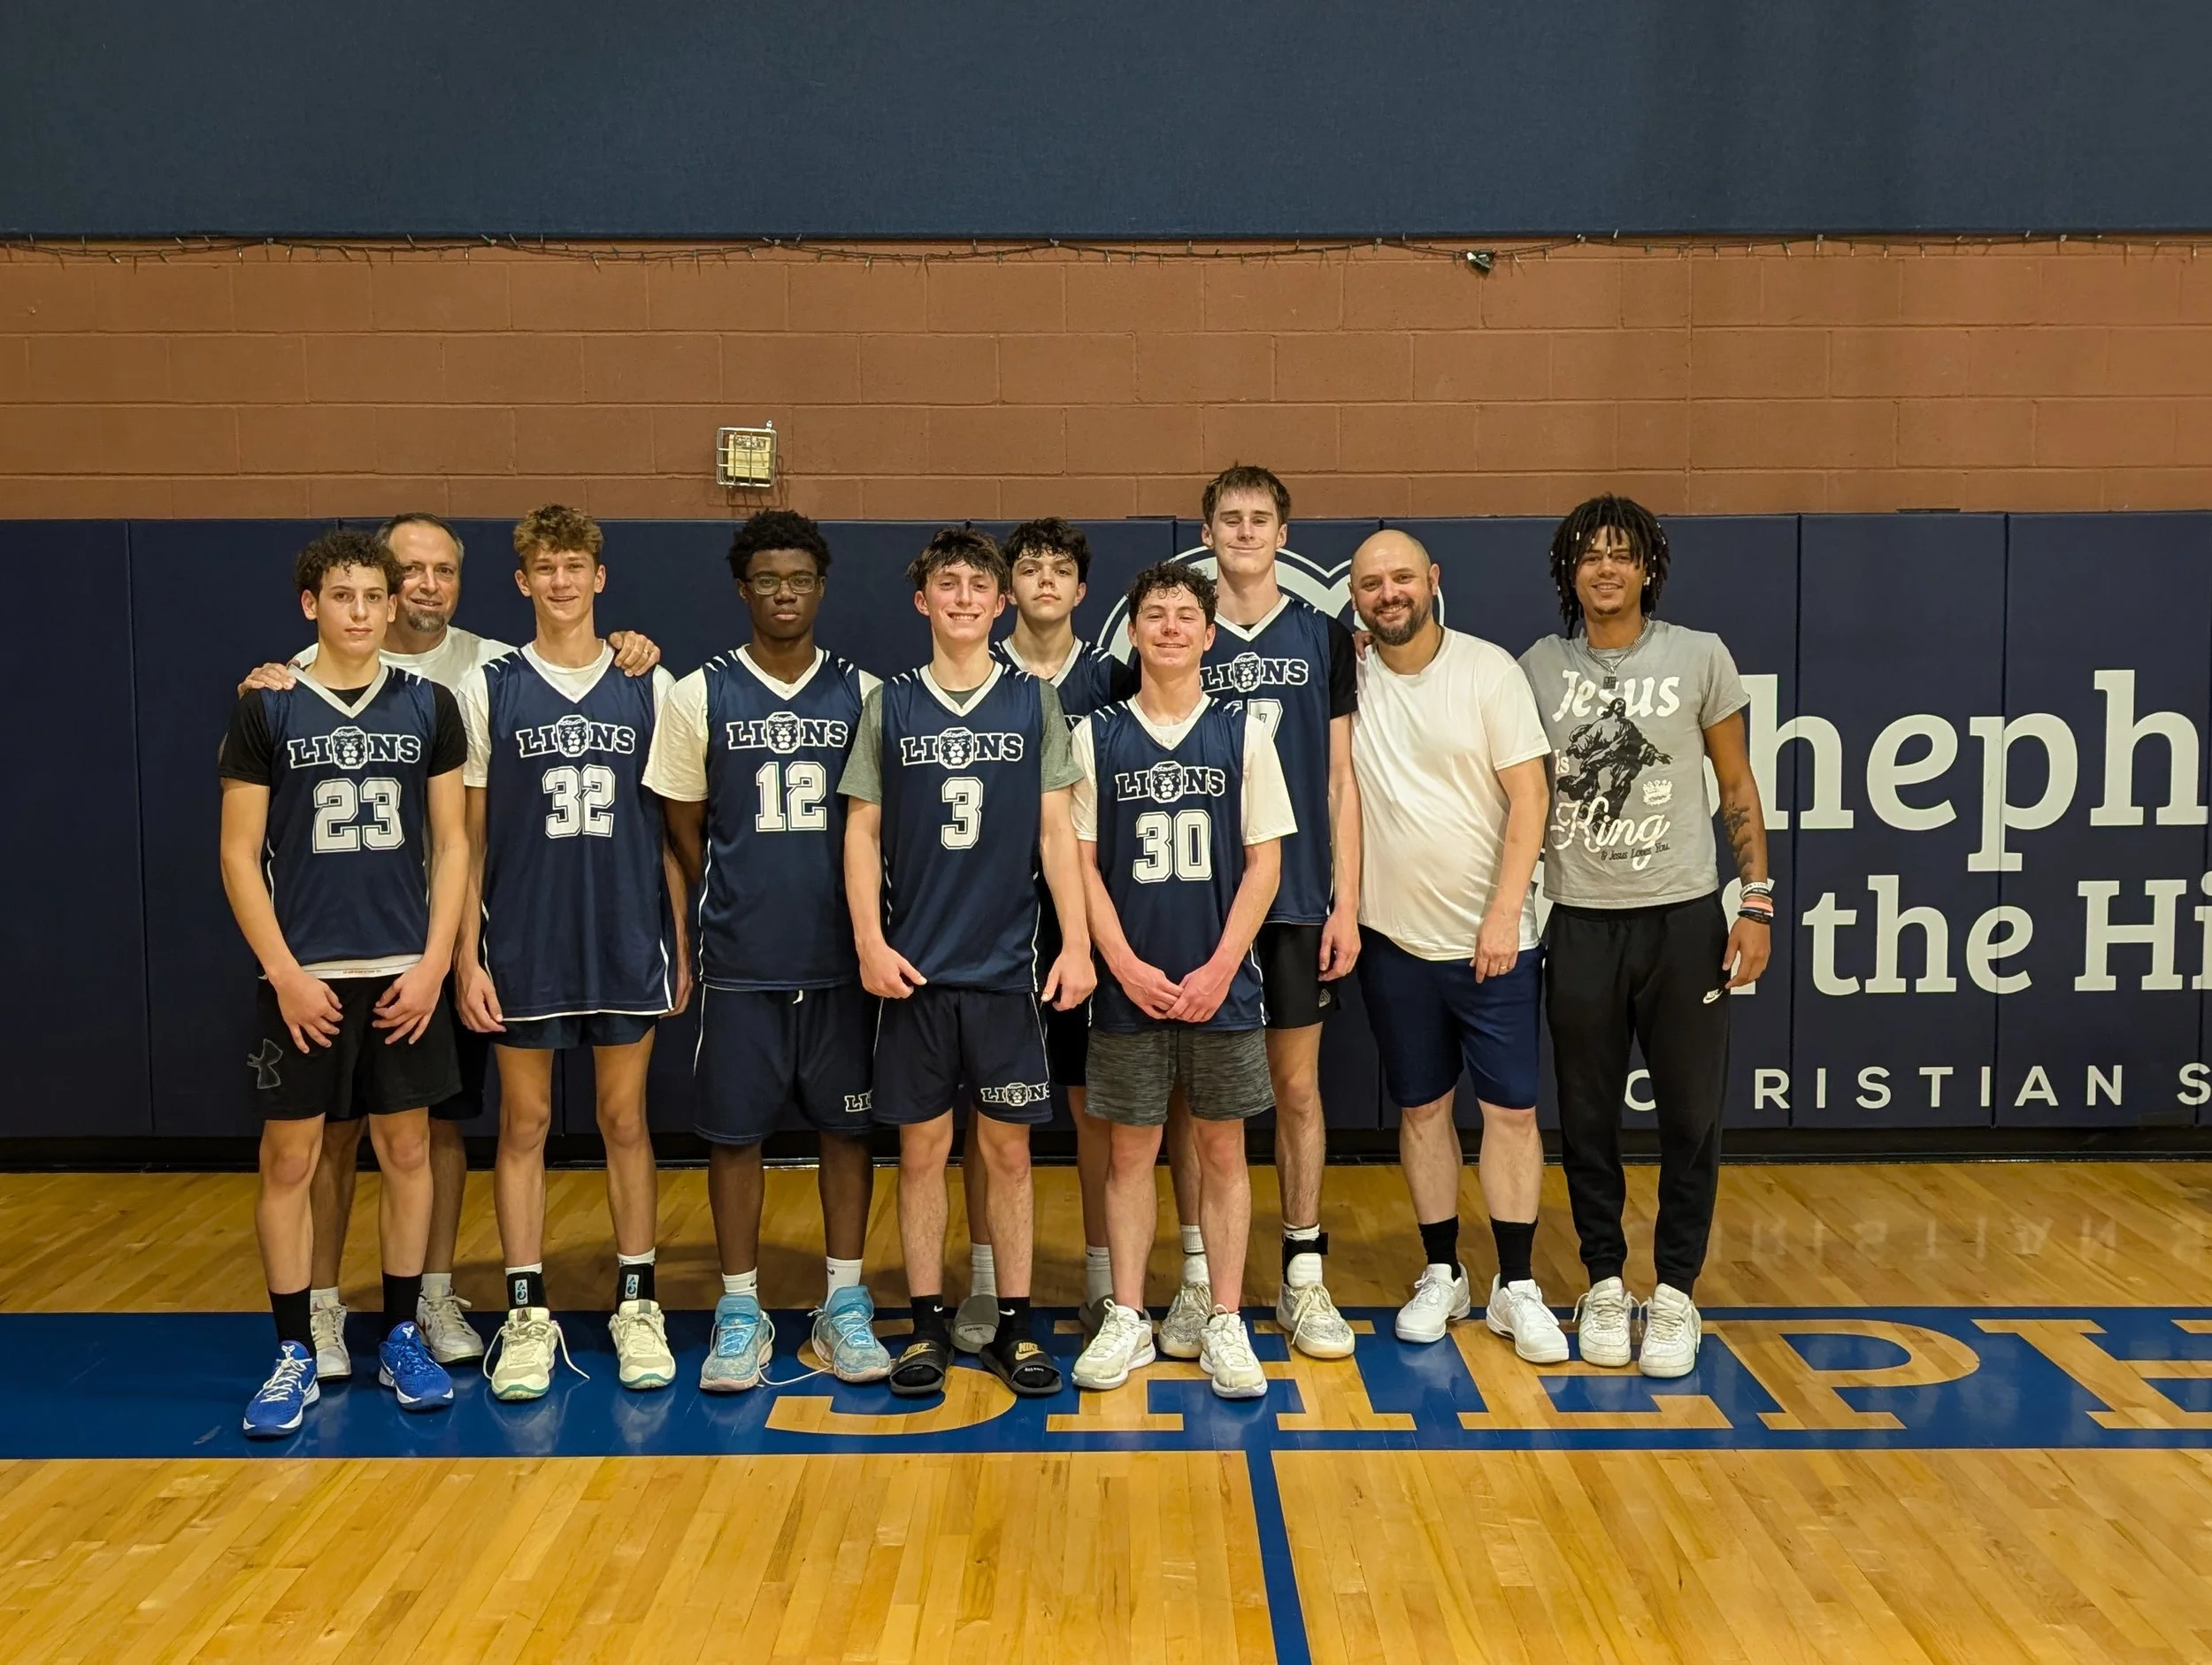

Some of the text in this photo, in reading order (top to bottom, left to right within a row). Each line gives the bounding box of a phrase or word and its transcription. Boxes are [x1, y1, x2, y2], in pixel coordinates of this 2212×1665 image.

[1552, 670, 1680, 723] Jesus
[541, 763, 617, 839] 32
[755, 761, 826, 832] 12
[1704, 670, 2208, 871] heph
[312, 777, 405, 854] 23
[941, 777, 984, 850] 3
[1133, 809, 1212, 883] 30
[1549, 796, 1671, 871] King
[1801, 875, 2033, 995] the
[1624, 1064, 2124, 1111] CRISTIAN
[1018, 1342, 1040, 1354] NIKE
